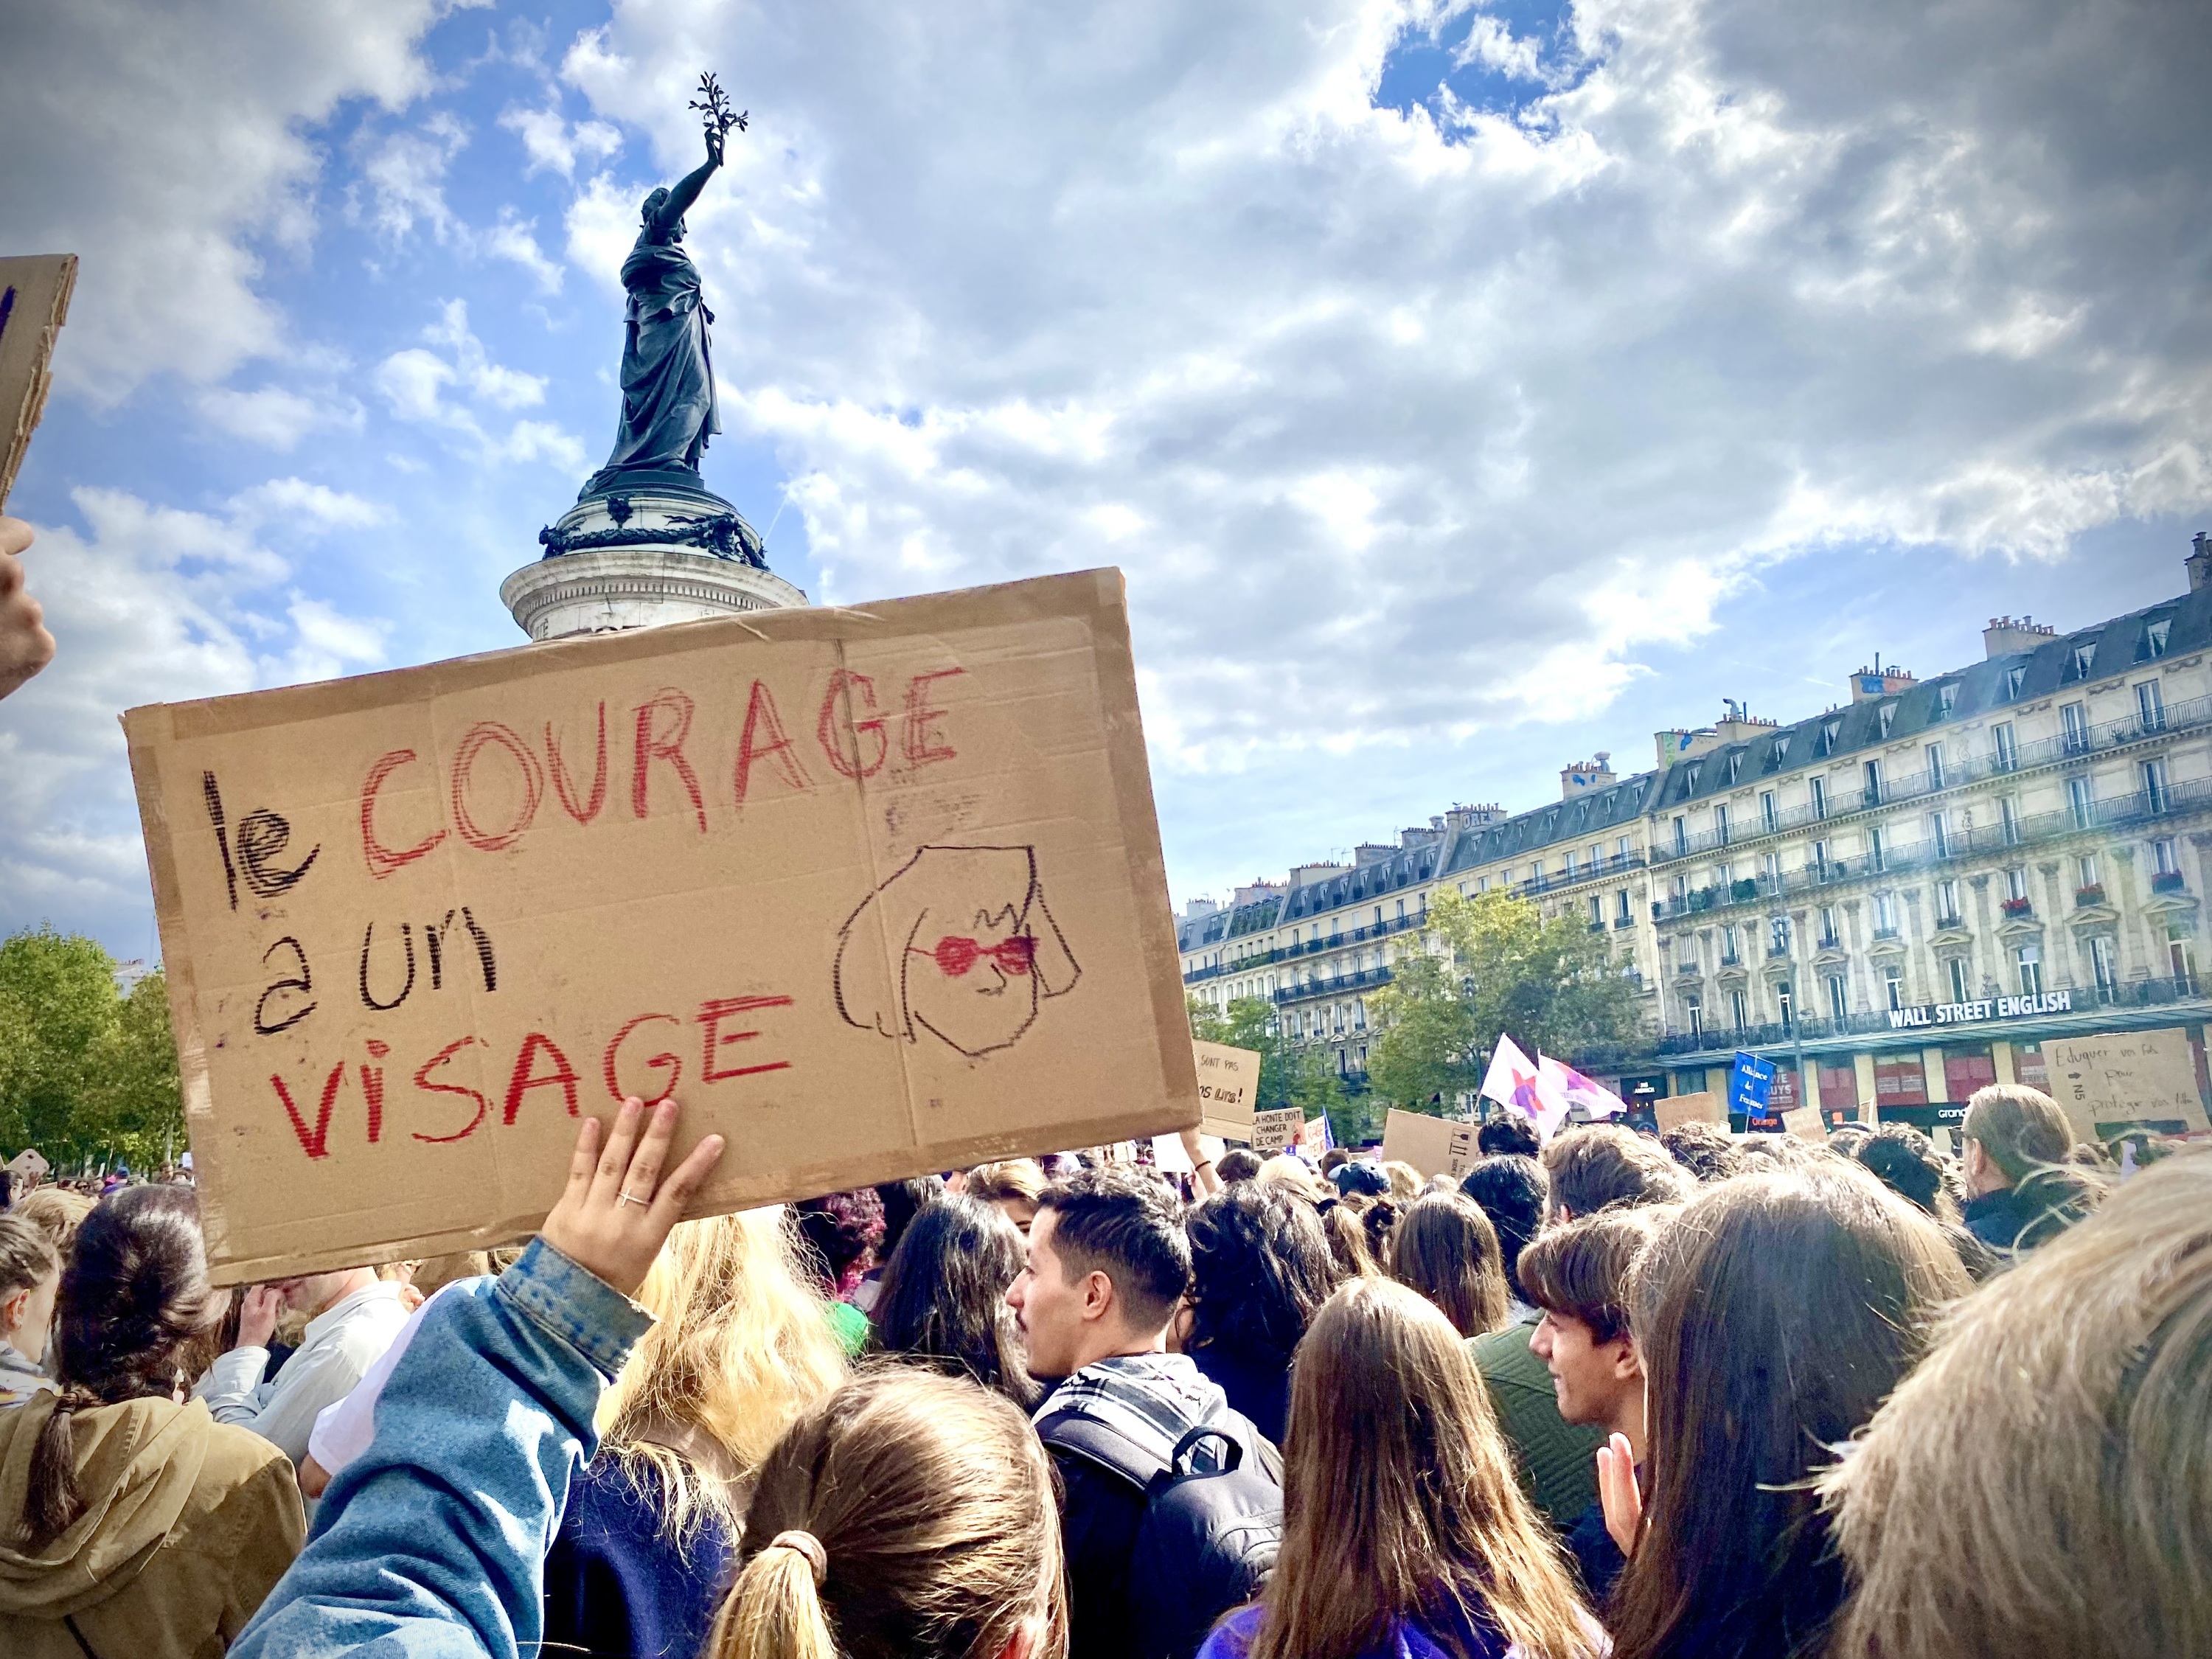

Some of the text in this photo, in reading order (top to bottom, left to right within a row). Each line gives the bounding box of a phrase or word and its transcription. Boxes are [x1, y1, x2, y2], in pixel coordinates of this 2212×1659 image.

[201, 665, 967, 911] le COURAGE
[1888, 990, 2072, 1029] WALL STREET ENGLISH
[1200, 1054, 1239, 1071] SONT PAS
[1262, 1113, 1283, 1123] HONTE
[1284, 1111, 1301, 1121] DOIT
[1752, 1118, 1778, 1127] Orange
[1256, 1124, 1287, 1135] CHANGER
[1255, 1135, 1284, 1147] DE CAMP
